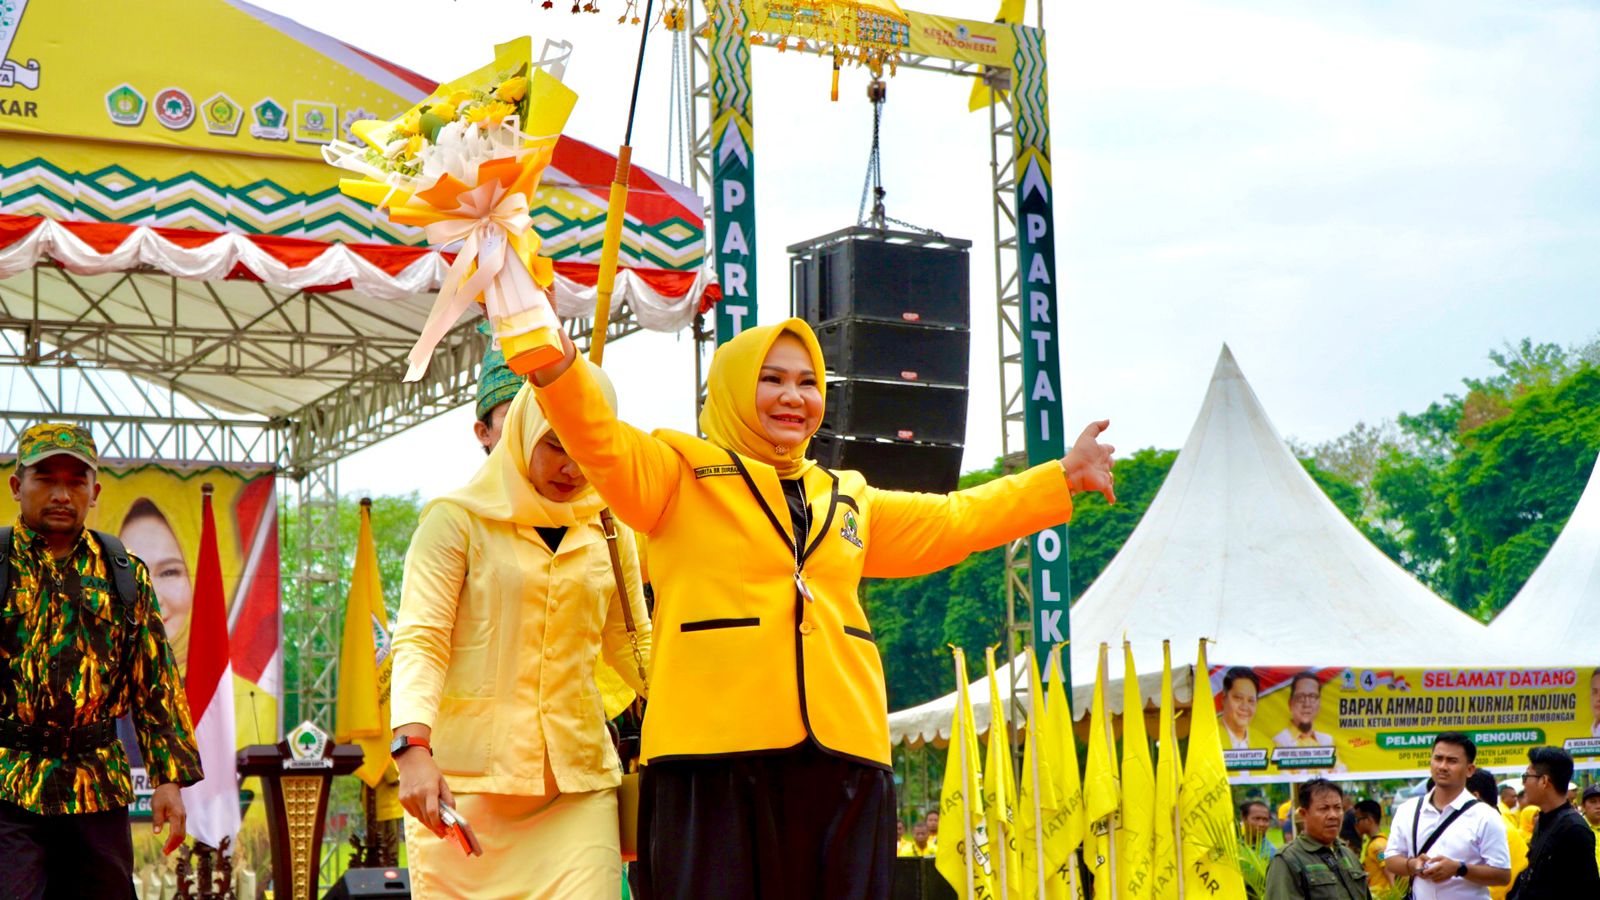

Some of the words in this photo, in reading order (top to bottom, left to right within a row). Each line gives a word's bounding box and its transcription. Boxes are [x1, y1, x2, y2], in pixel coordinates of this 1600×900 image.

[722, 179, 749, 338] PART
[1026, 213, 1056, 441] PARTAI
[1364, 673, 1373, 687] 4
[1423, 671, 1506, 688] SELAMAT
[1509, 670, 1576, 687] DATANG
[1339, 697, 1383, 716] BAPAK
[1386, 697, 1434, 715] AHMAD
[1437, 696, 1465, 714] DOLI
[1468, 695, 1514, 713] KURNIA
[1518, 693, 1576, 712] TANDJUNG
[1339, 718, 1365, 728] WAKIL
[1367, 717, 1392, 728] KETUA
[1393, 717, 1419, 727] UMUM
[1438, 716, 1464, 726] PARTAI
[1466, 714, 1495, 725] GOLKAR
[1497, 713, 1528, 724] BESERTA
[1529, 712, 1575, 723] ROMBONGAN
[1385, 734, 1438, 746] PELANT
[1475, 731, 1537, 743] PENGURUS
[1412, 751, 1431, 759] PARTA
[1476, 749, 1496, 757] PATEN
[1499, 748, 1524, 756] LANGKAT
